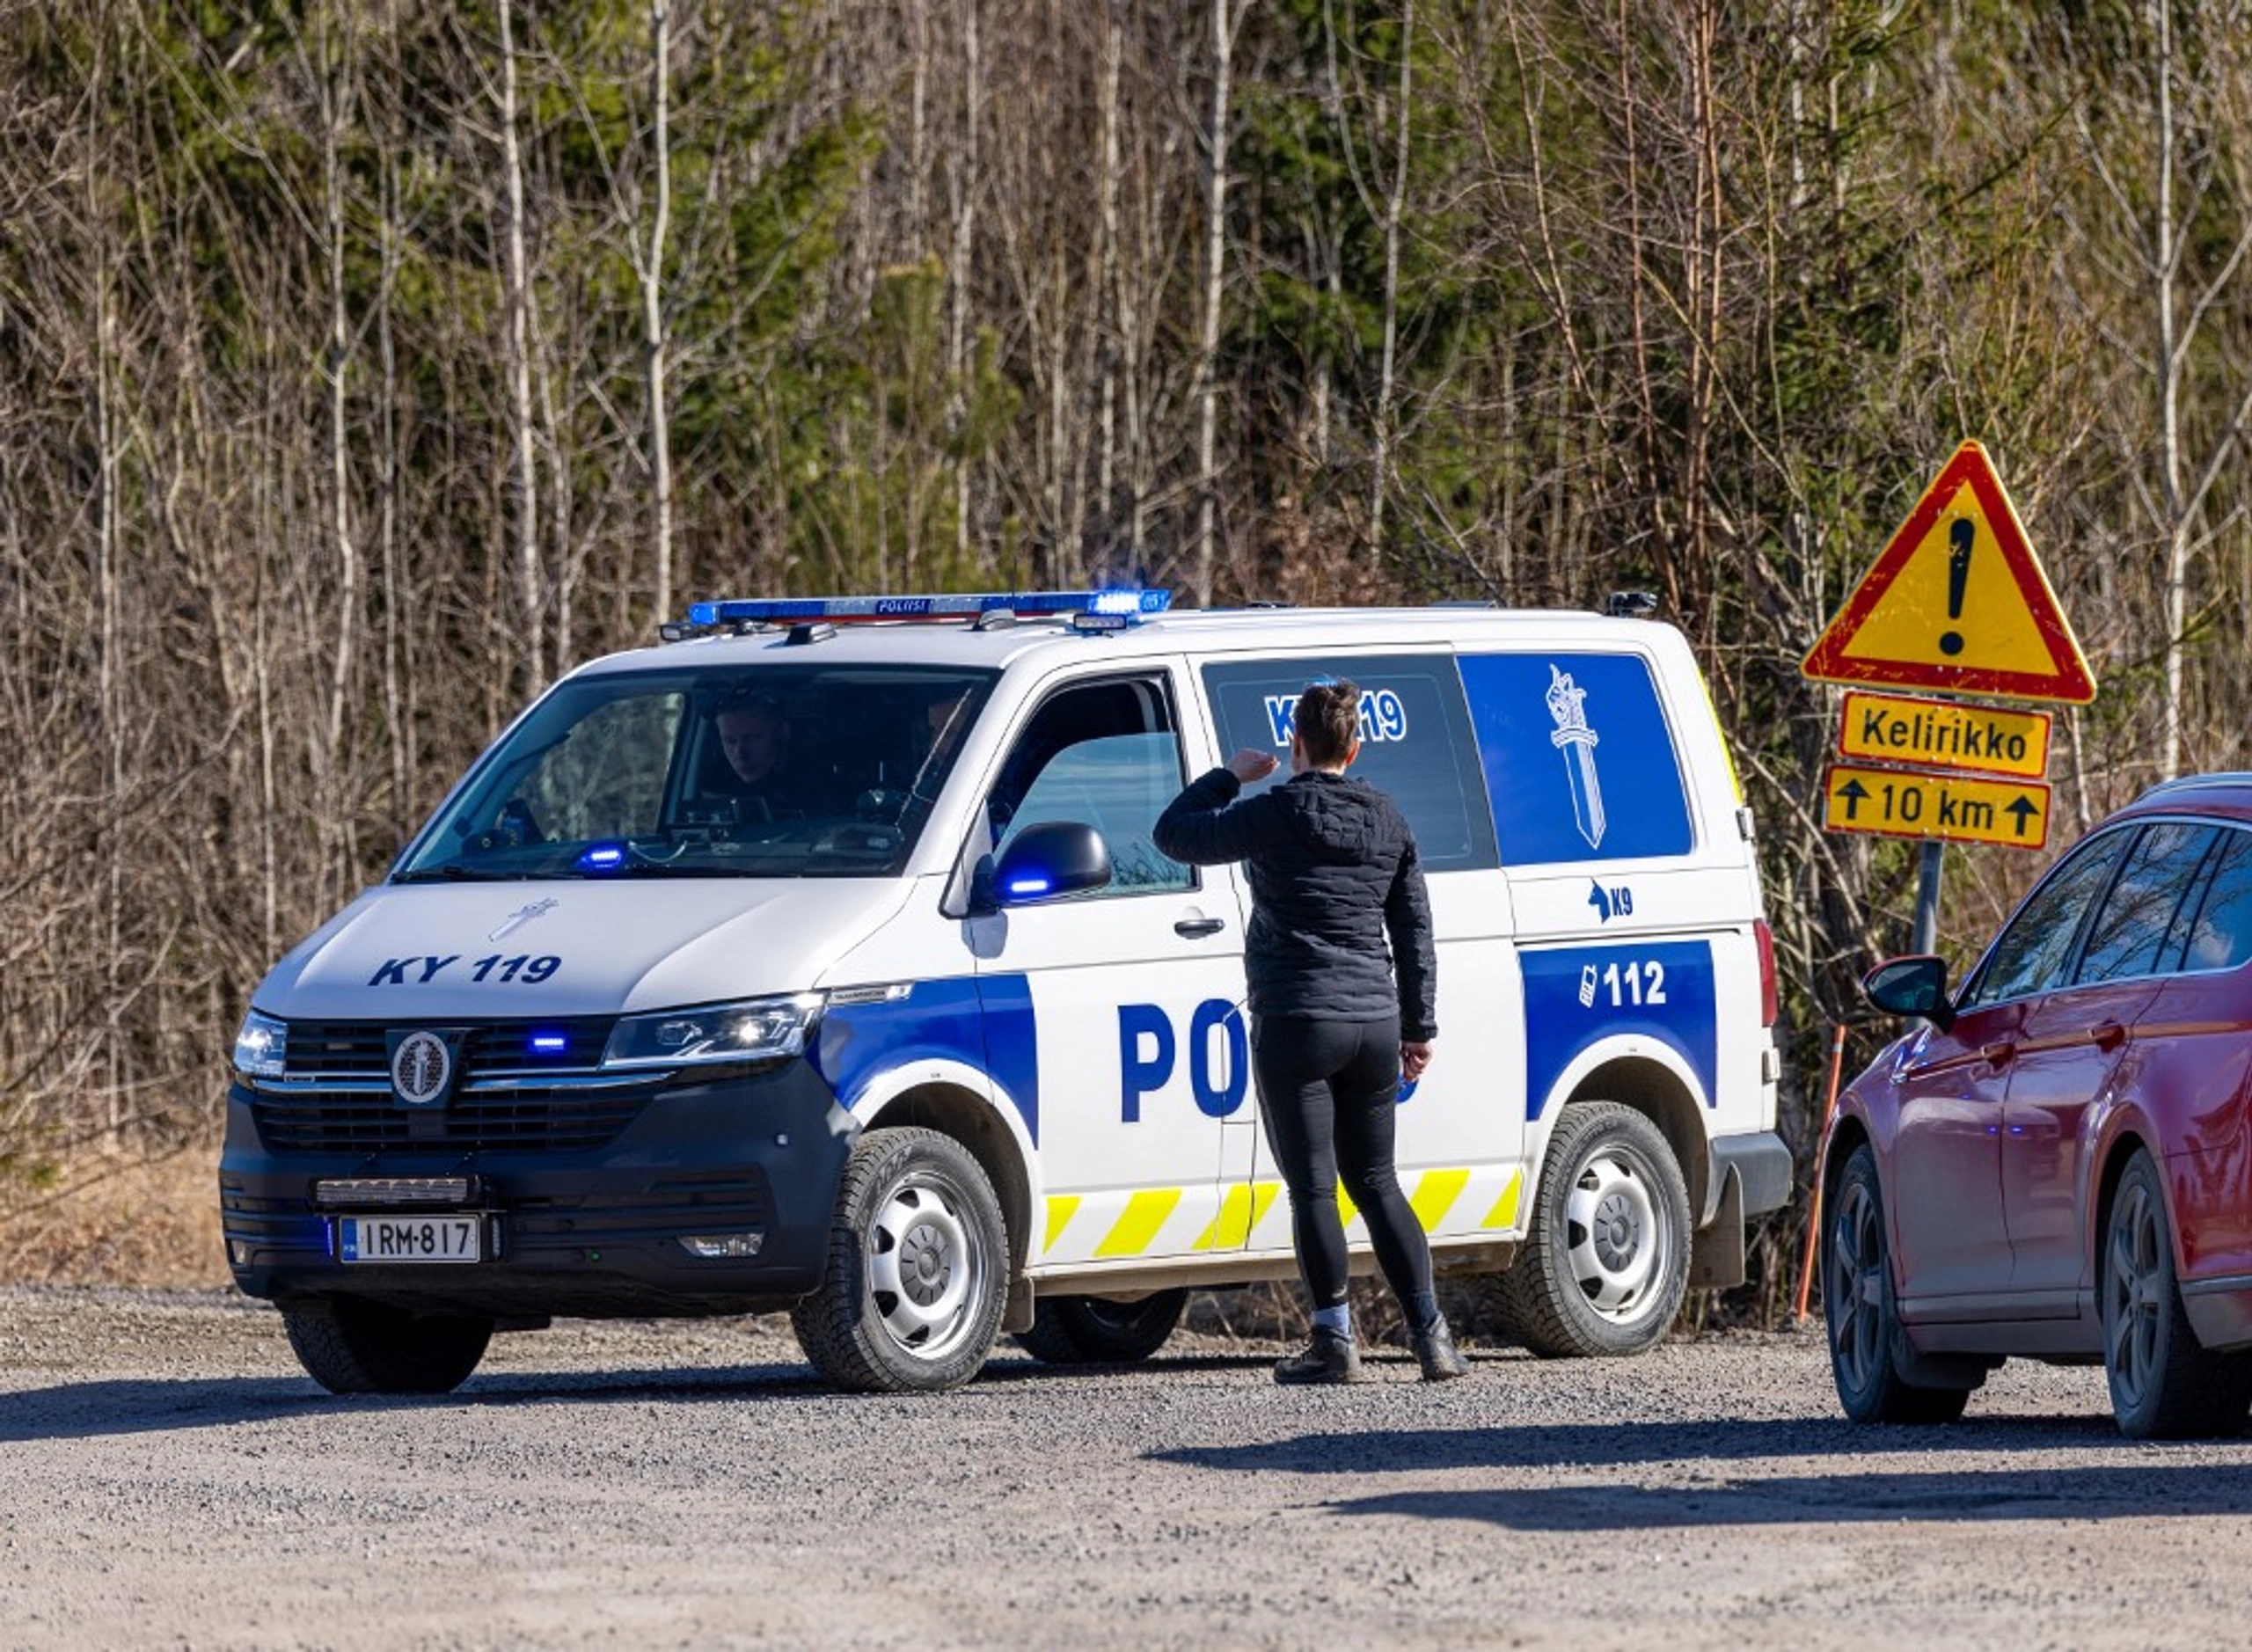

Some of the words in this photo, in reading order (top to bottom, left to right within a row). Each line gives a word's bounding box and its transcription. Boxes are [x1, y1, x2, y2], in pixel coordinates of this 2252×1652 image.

[1265, 695, 1304, 746] K
[1356, 690, 1407, 742] 19
[1862, 708, 2027, 762] Kelirikko
[1883, 785, 1923, 822] 10
[1938, 790, 1994, 830] km
[1610, 887, 1634, 916] K9
[368, 954, 463, 986] KY
[472, 954, 562, 983] 119
[1603, 961, 1667, 1006] 112
[366, 1223, 470, 1254] IRM-817
